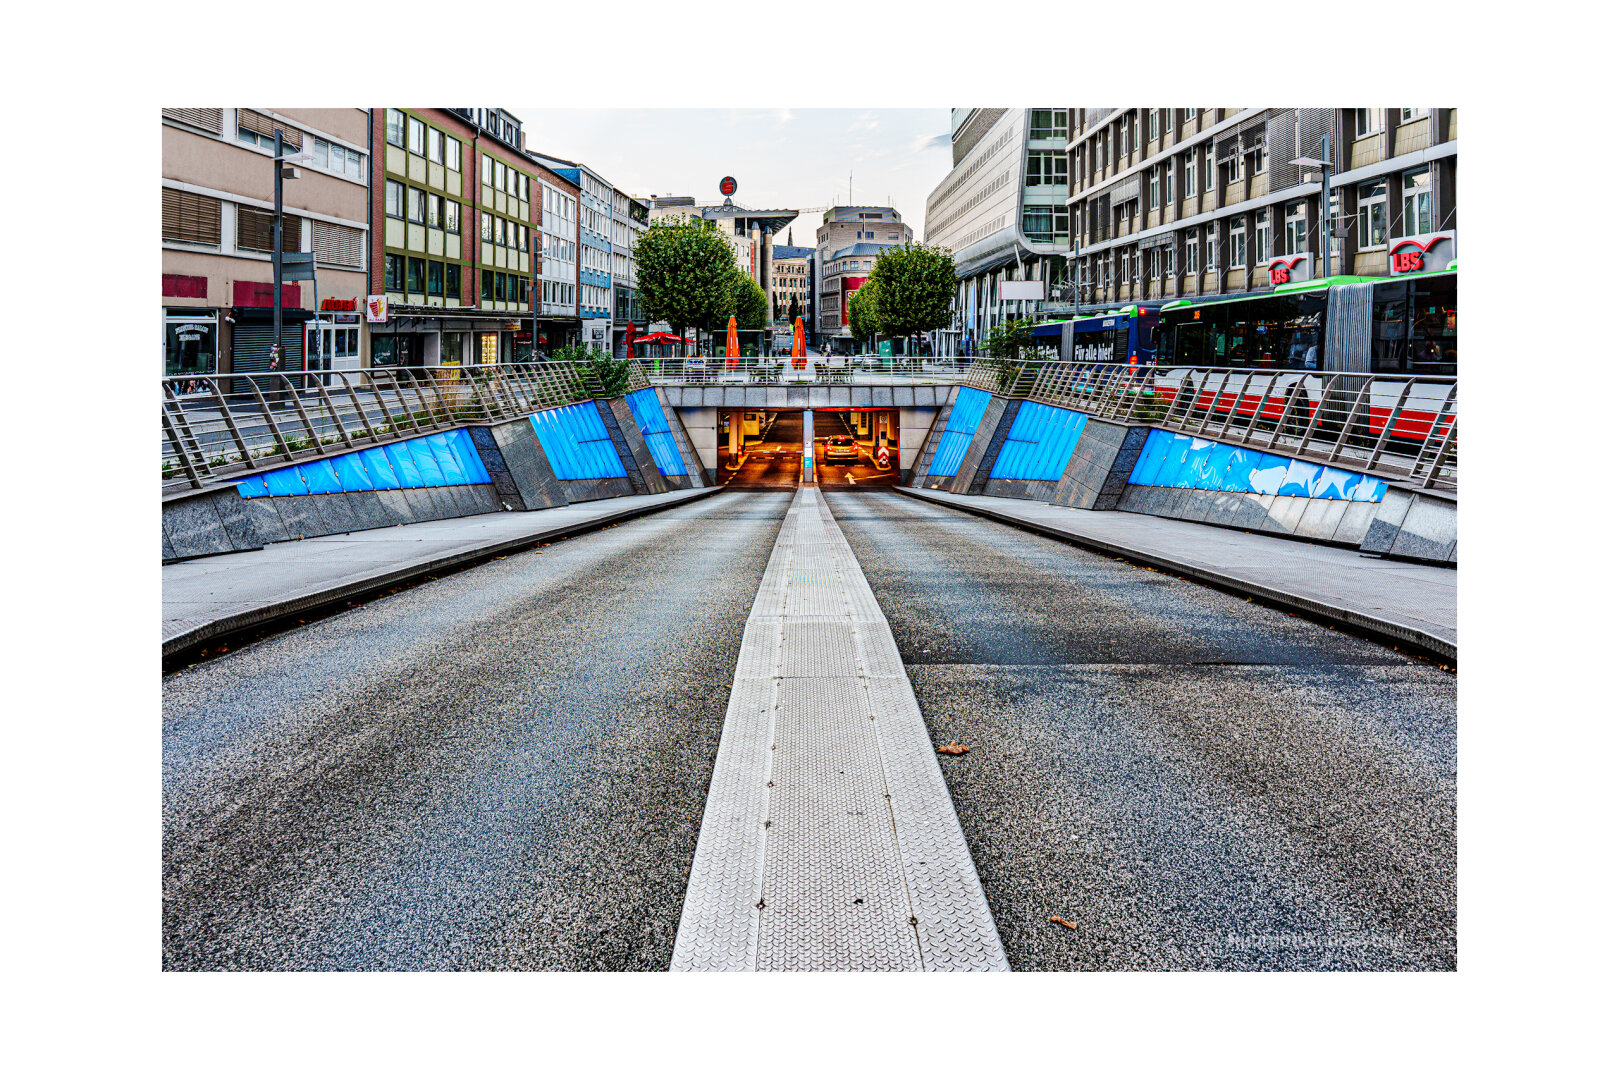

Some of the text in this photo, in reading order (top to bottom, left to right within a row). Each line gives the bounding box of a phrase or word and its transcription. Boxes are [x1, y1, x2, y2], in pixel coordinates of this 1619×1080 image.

[1393, 251, 1424, 272] LBS
[1270, 268, 1290, 284] LBS
[1074, 342, 1114, 361] Für alle hier!
